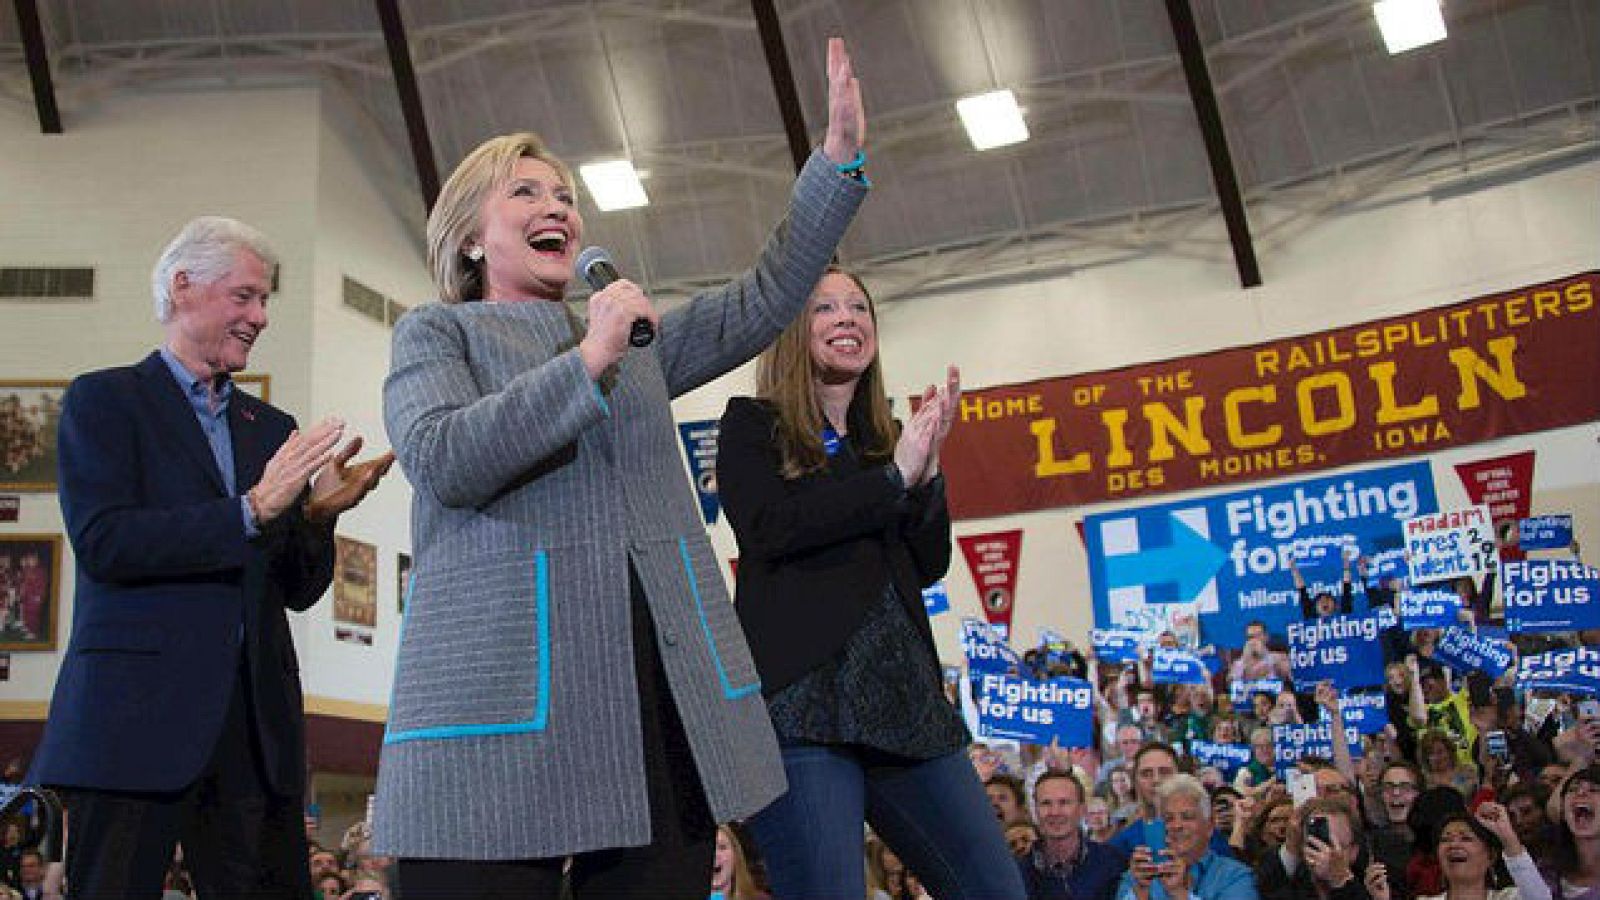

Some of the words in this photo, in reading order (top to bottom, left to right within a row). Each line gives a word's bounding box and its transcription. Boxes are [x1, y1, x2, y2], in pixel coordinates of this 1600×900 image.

[1073, 384, 1106, 406] OF
[1138, 370, 1193, 395] THE
[1255, 281, 1593, 378] RAILSPLITTERS
[1030, 336, 1526, 478] LINCOLN
[1107, 467, 1164, 491] DES
[1374, 421, 1450, 450] IOWA
[1226, 477, 1419, 539] Fighting
[1427, 605, 1445, 615] us
[1505, 586, 1547, 607] for
[1554, 588, 1591, 604] us
[1288, 615, 1376, 646] Fighting
[1288, 649, 1317, 670] for
[1320, 647, 1348, 665] us
[982, 676, 1092, 710] Fighting
[979, 696, 1018, 720] for
[1022, 707, 1054, 725] us
[1275, 744, 1304, 761] for
